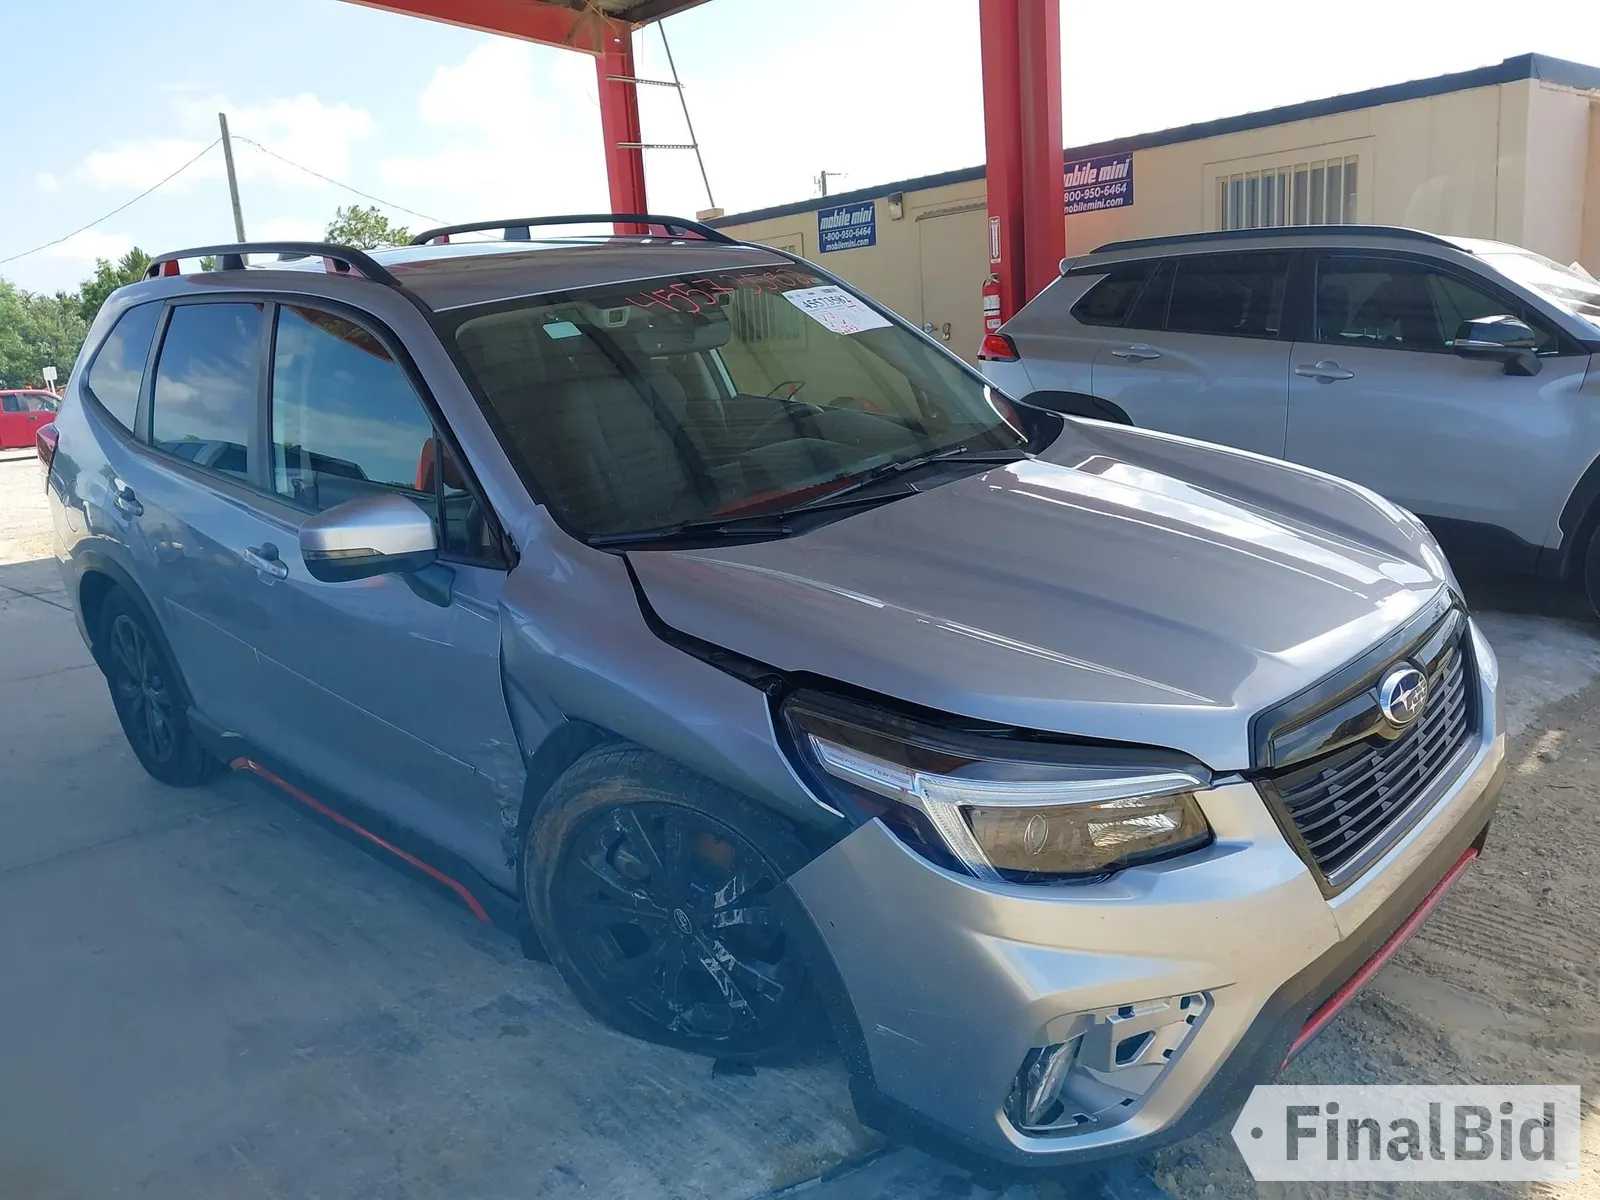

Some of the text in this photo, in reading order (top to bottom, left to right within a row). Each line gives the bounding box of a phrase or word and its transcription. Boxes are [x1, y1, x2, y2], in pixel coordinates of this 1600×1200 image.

[1098, 158, 1130, 182] mini
[1064, 182, 1127, 203] 800-950-6464
[820, 205, 873, 230] mobile mini
[822, 226, 872, 242] 1-800-950-6464
[825, 238, 870, 251] mobilemini.com
